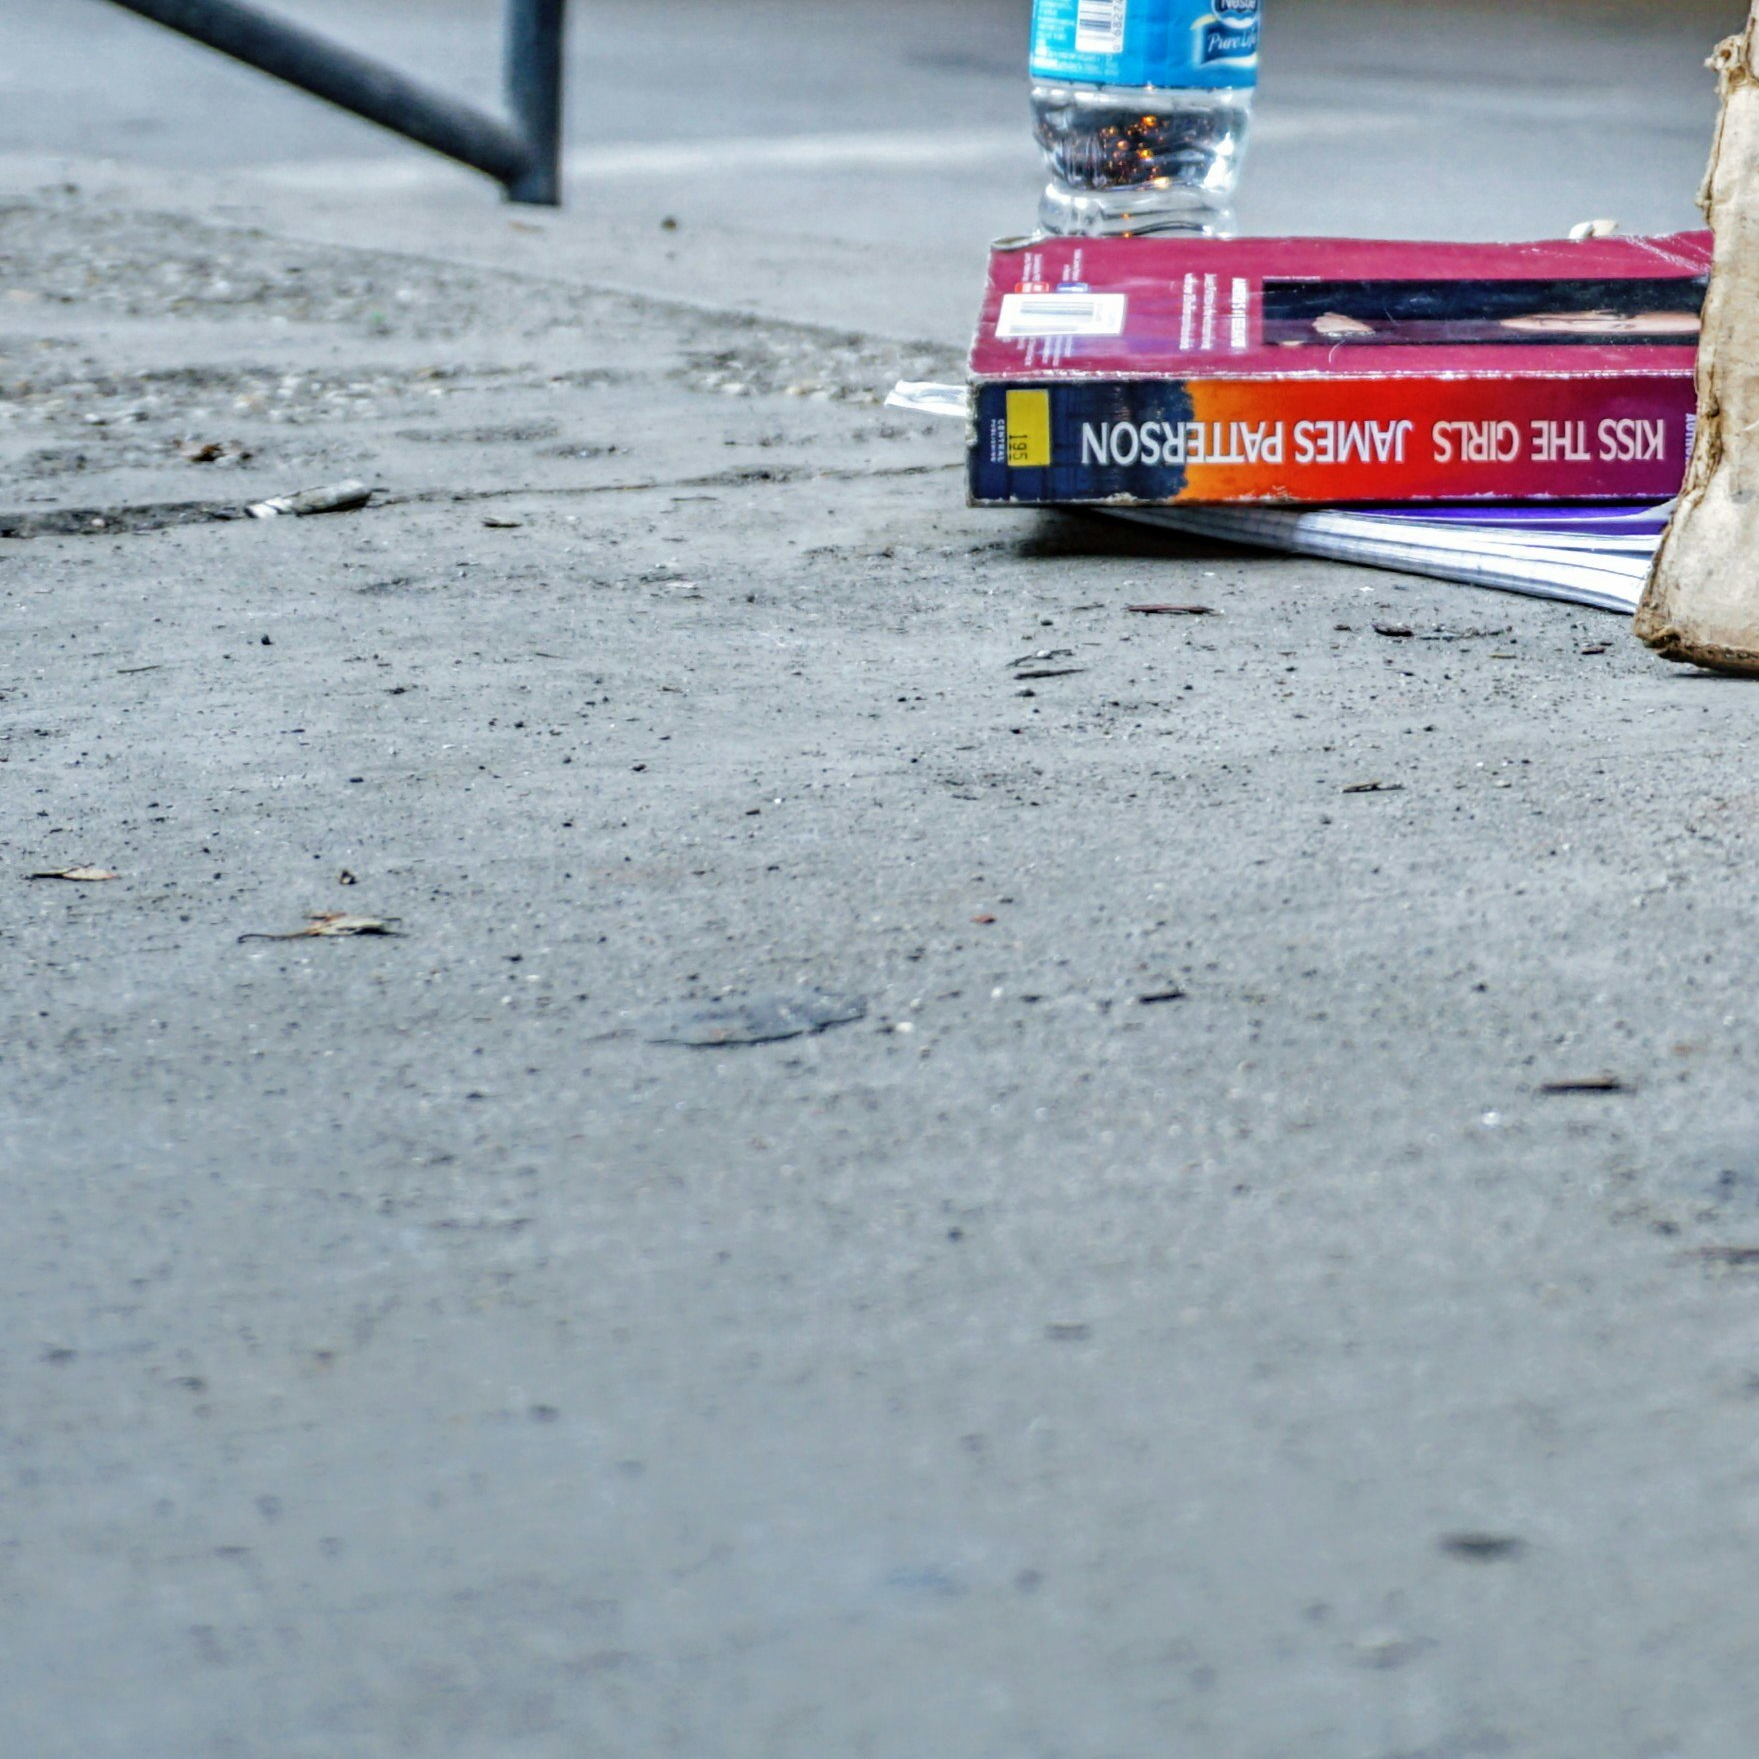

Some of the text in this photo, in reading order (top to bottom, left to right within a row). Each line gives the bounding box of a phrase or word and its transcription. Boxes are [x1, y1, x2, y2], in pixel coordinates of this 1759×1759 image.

[1208, 29, 1240, 53] Pure
[1081, 419, 1414, 466] JAMES PATTERSON
[1431, 418, 1666, 463] KISS THE GIRLS
